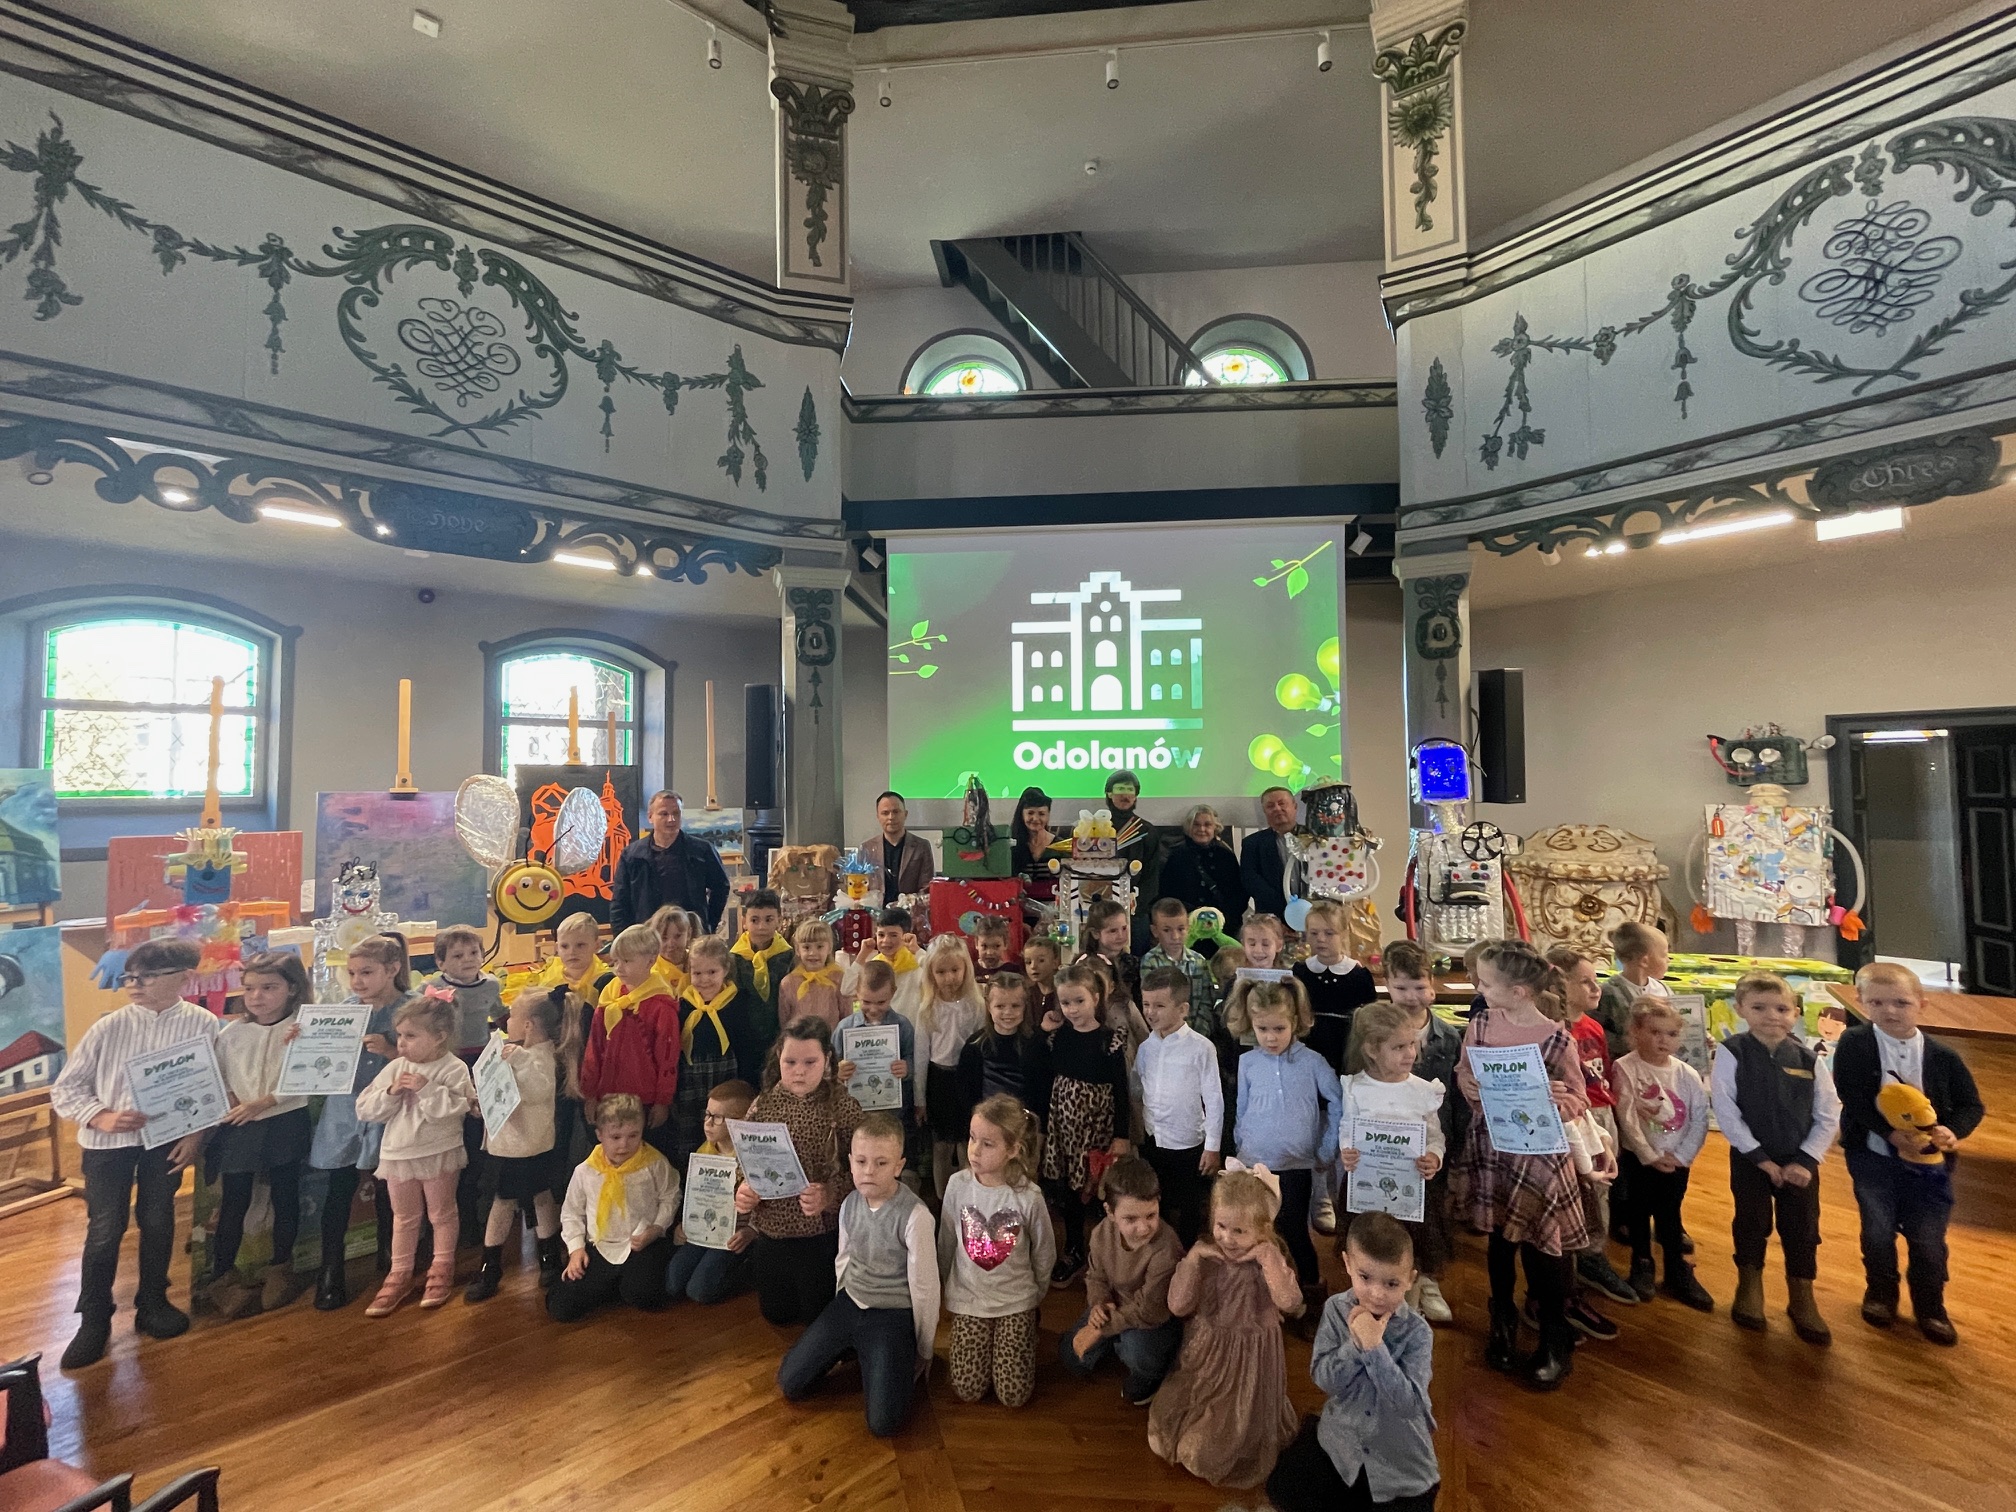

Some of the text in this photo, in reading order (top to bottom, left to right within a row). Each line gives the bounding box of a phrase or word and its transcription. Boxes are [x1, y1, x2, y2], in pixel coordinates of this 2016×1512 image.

[1013, 737, 1203, 770] Odolanów
[310, 1017, 355, 1026] DYPLOM
[854, 1038, 888, 1049] DYPLOM
[143, 1052, 195, 1077] DYPLOM
[1482, 1061, 1527, 1073] DYPLOM
[740, 1133, 777, 1143] DYPLOM
[1365, 1131, 1411, 1146] DYPLOM
[698, 1167, 732, 1179] DYPLOM
